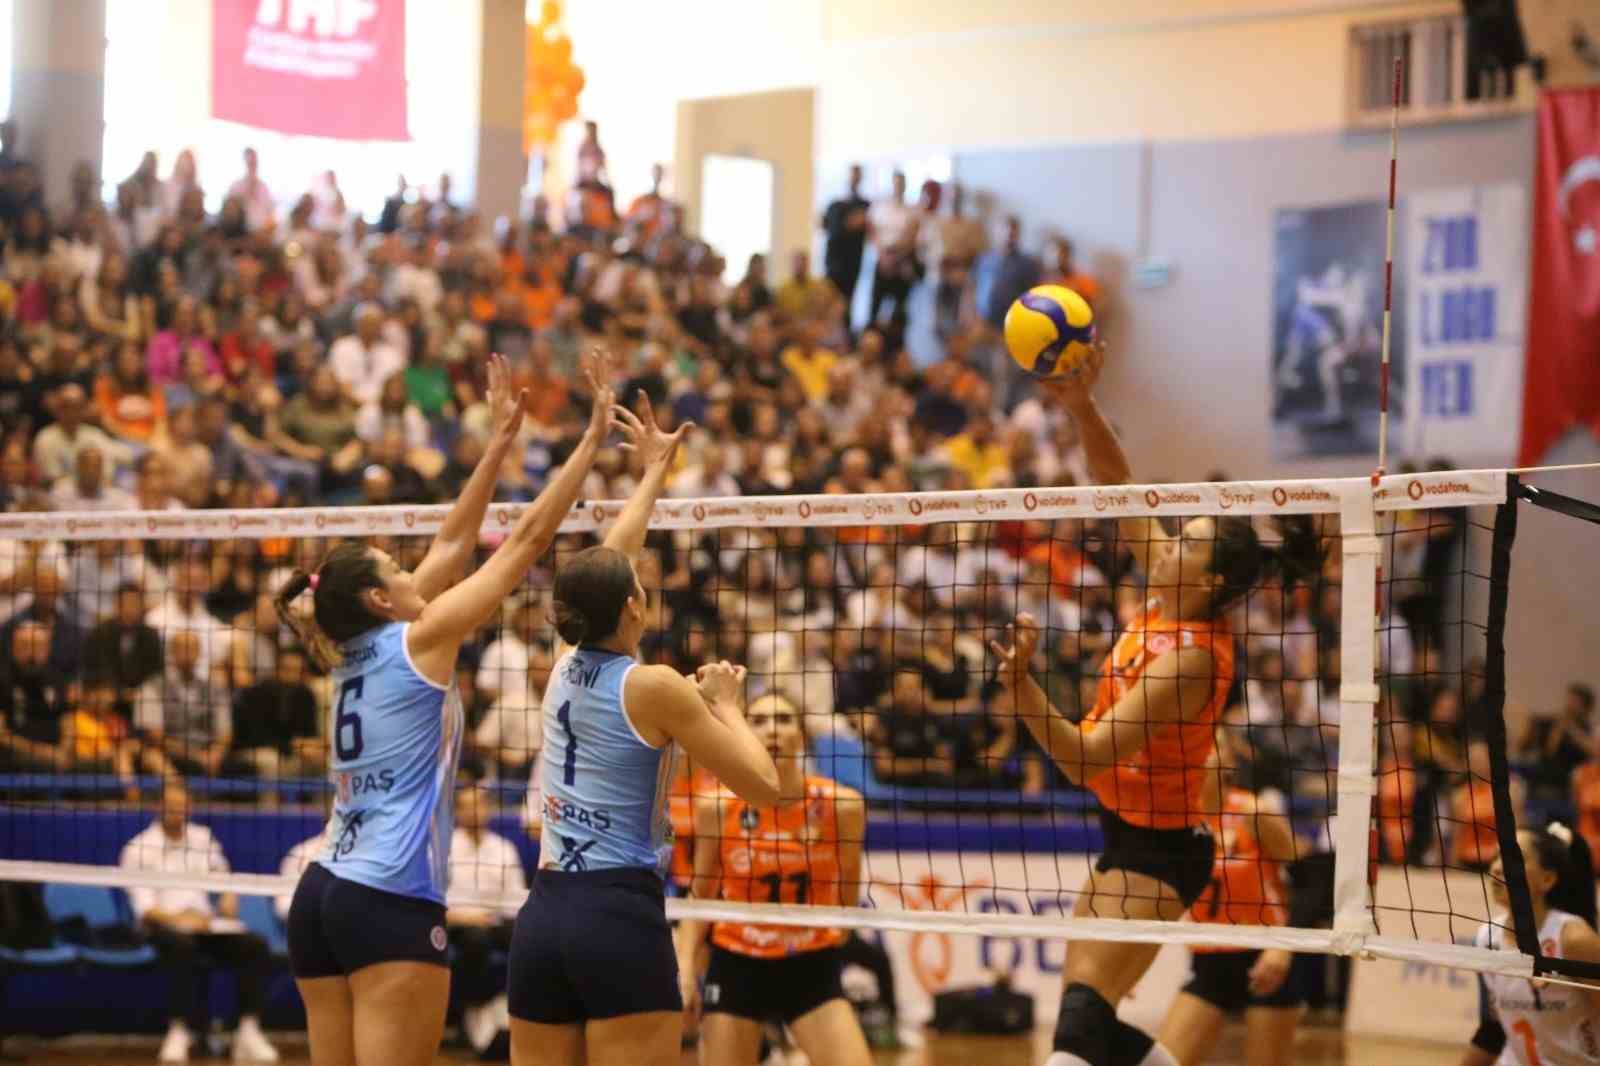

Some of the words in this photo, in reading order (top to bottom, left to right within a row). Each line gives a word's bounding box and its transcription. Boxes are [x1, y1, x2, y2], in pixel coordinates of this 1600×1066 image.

[1108, 495, 1128, 506] TVF
[1160, 492, 1200, 504] vodafone
[1235, 493, 1255, 504] TVF
[1289, 490, 1330, 501] vodafone
[1424, 482, 1470, 494] vodafone
[334, 674, 365, 763] 6
[557, 699, 577, 786] 1
